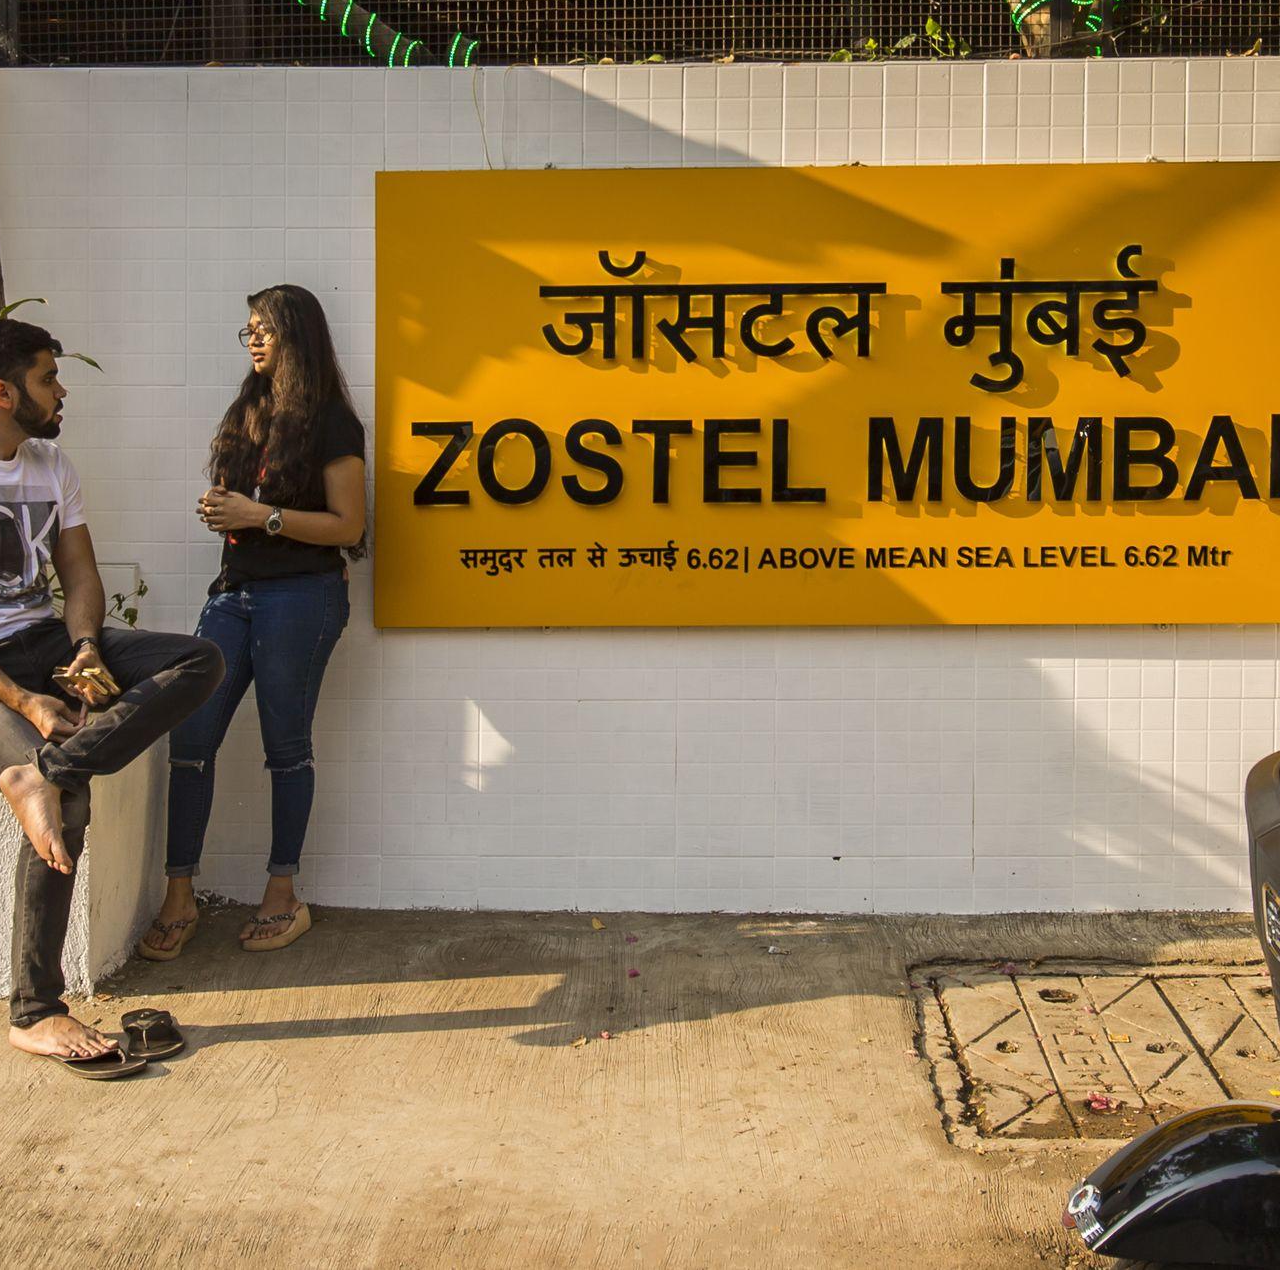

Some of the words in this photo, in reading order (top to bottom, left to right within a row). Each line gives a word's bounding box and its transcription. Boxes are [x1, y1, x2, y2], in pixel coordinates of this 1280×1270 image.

[540, 251, 886, 362] जॉसटल
[942, 245, 1158, 392] मुंबई
[412, 419, 826, 507] ZOSTEL
[538, 548, 577, 568] तल
[587, 542, 608, 568] से
[618, 541, 679, 571] ऊचाई
[758, 547, 855, 569] ABOVE
[866, 547, 946, 569] MEAN
[957, 546, 1013, 568] SEA
[1024, 546, 1114, 568] LEVEL
[1125, 545, 1177, 567] 6.62
[1188, 546, 1231, 566] Mtr
